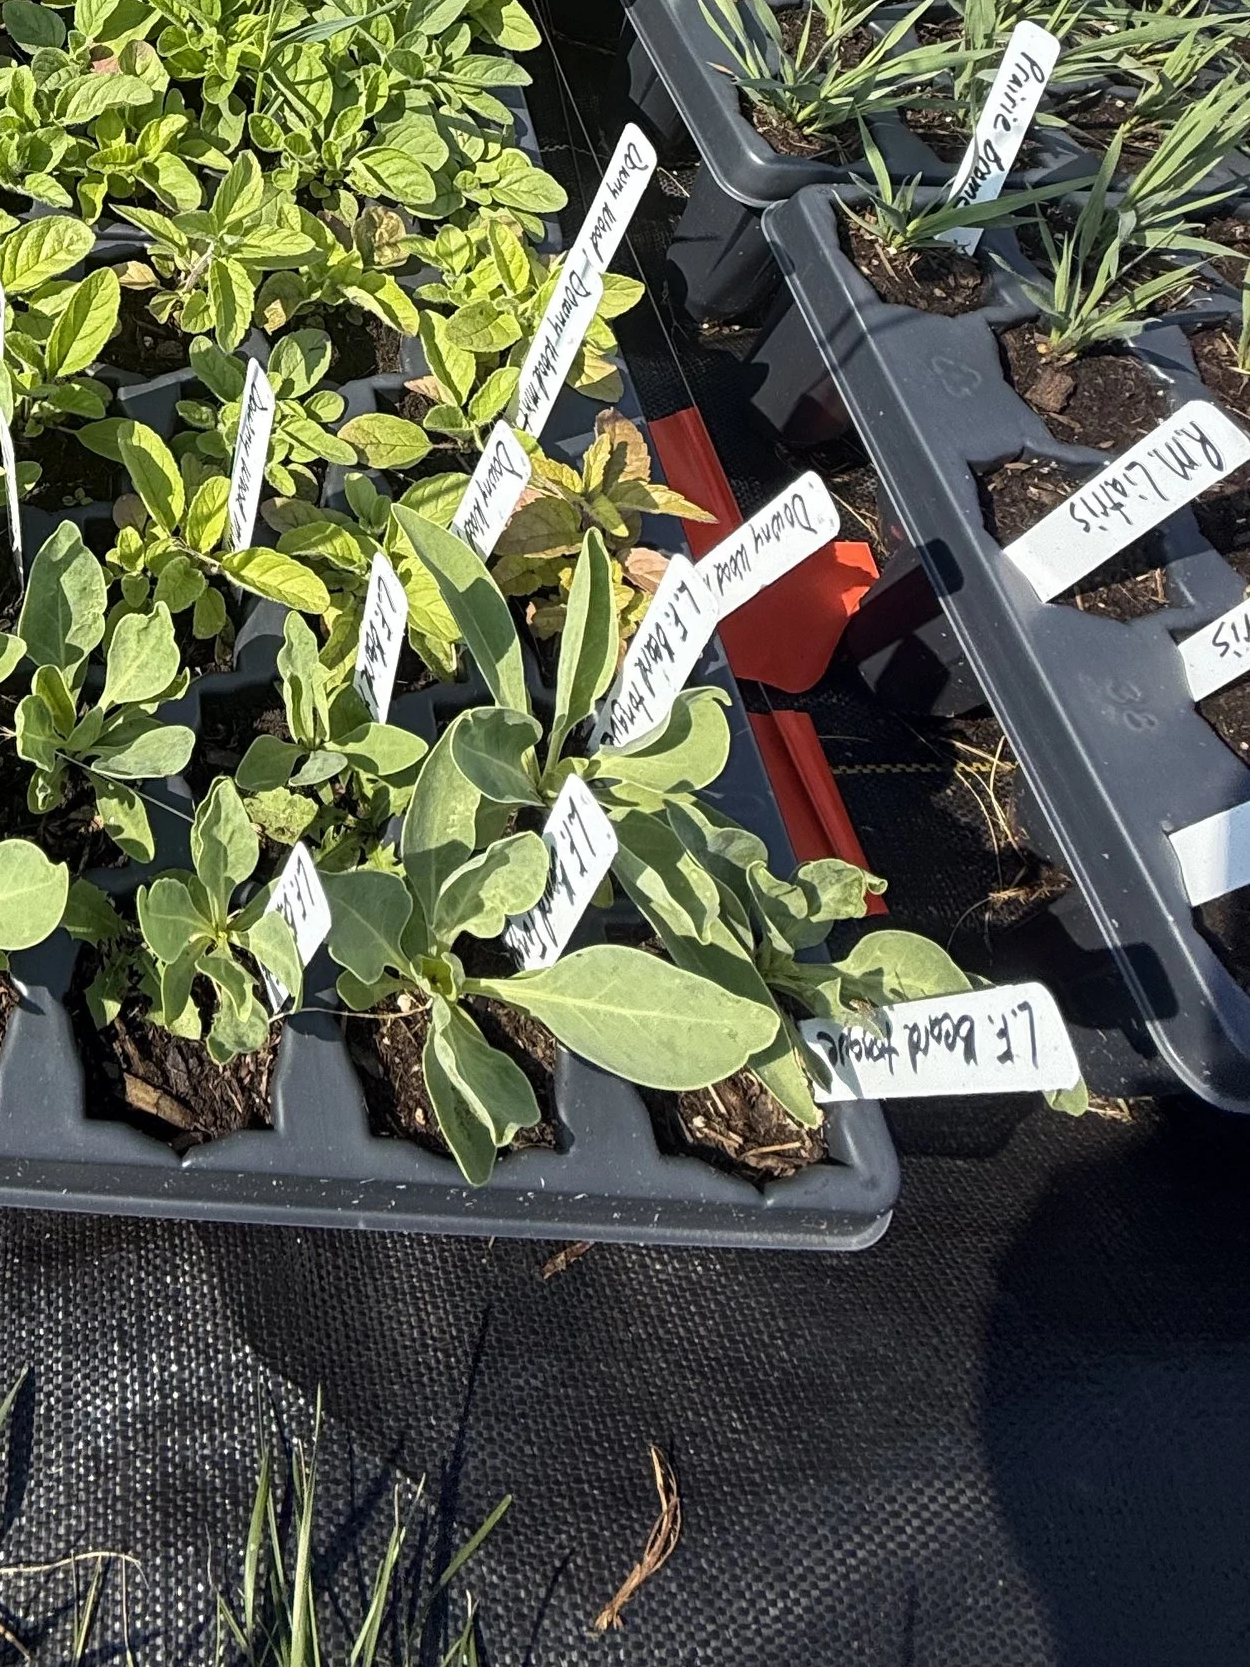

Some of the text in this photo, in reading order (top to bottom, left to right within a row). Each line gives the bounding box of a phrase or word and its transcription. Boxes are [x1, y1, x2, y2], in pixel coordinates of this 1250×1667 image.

[992, 51, 1046, 133] Prairie
[589, 141, 650, 264] Downy Wood
[553, 269, 593, 335] Downy
[531, 339, 561, 402] Wood
[480, 439, 524, 506] Downy
[1068, 420, 1227, 534] R.M. Liatris
[713, 492, 819, 597] Downy Wood
[815, 1019, 901, 1077] tongue
